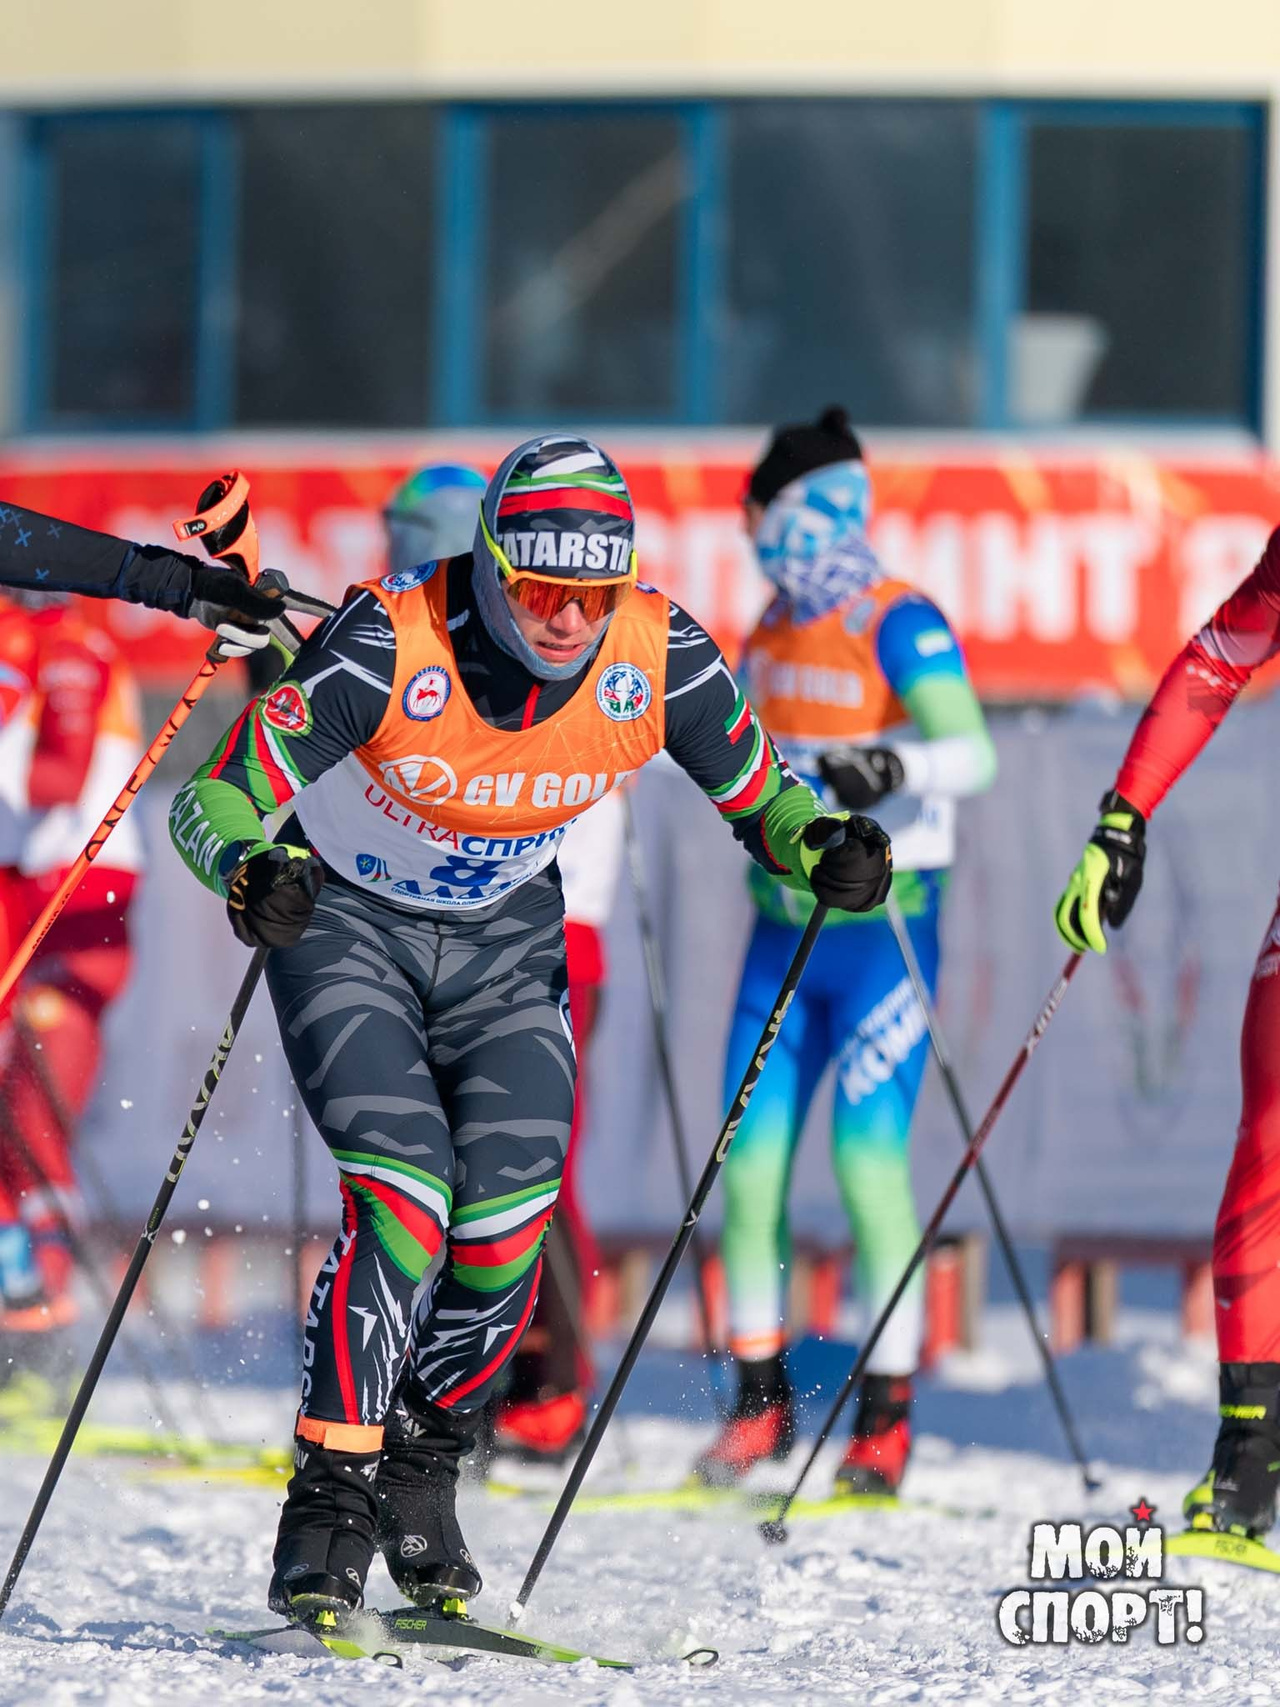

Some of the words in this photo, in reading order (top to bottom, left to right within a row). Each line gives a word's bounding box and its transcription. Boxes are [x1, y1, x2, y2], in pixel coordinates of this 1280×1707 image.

[462, 772, 528, 808] GV
[429, 855, 506, 888] 8
[394, 1618, 428, 1631] FISCHER
